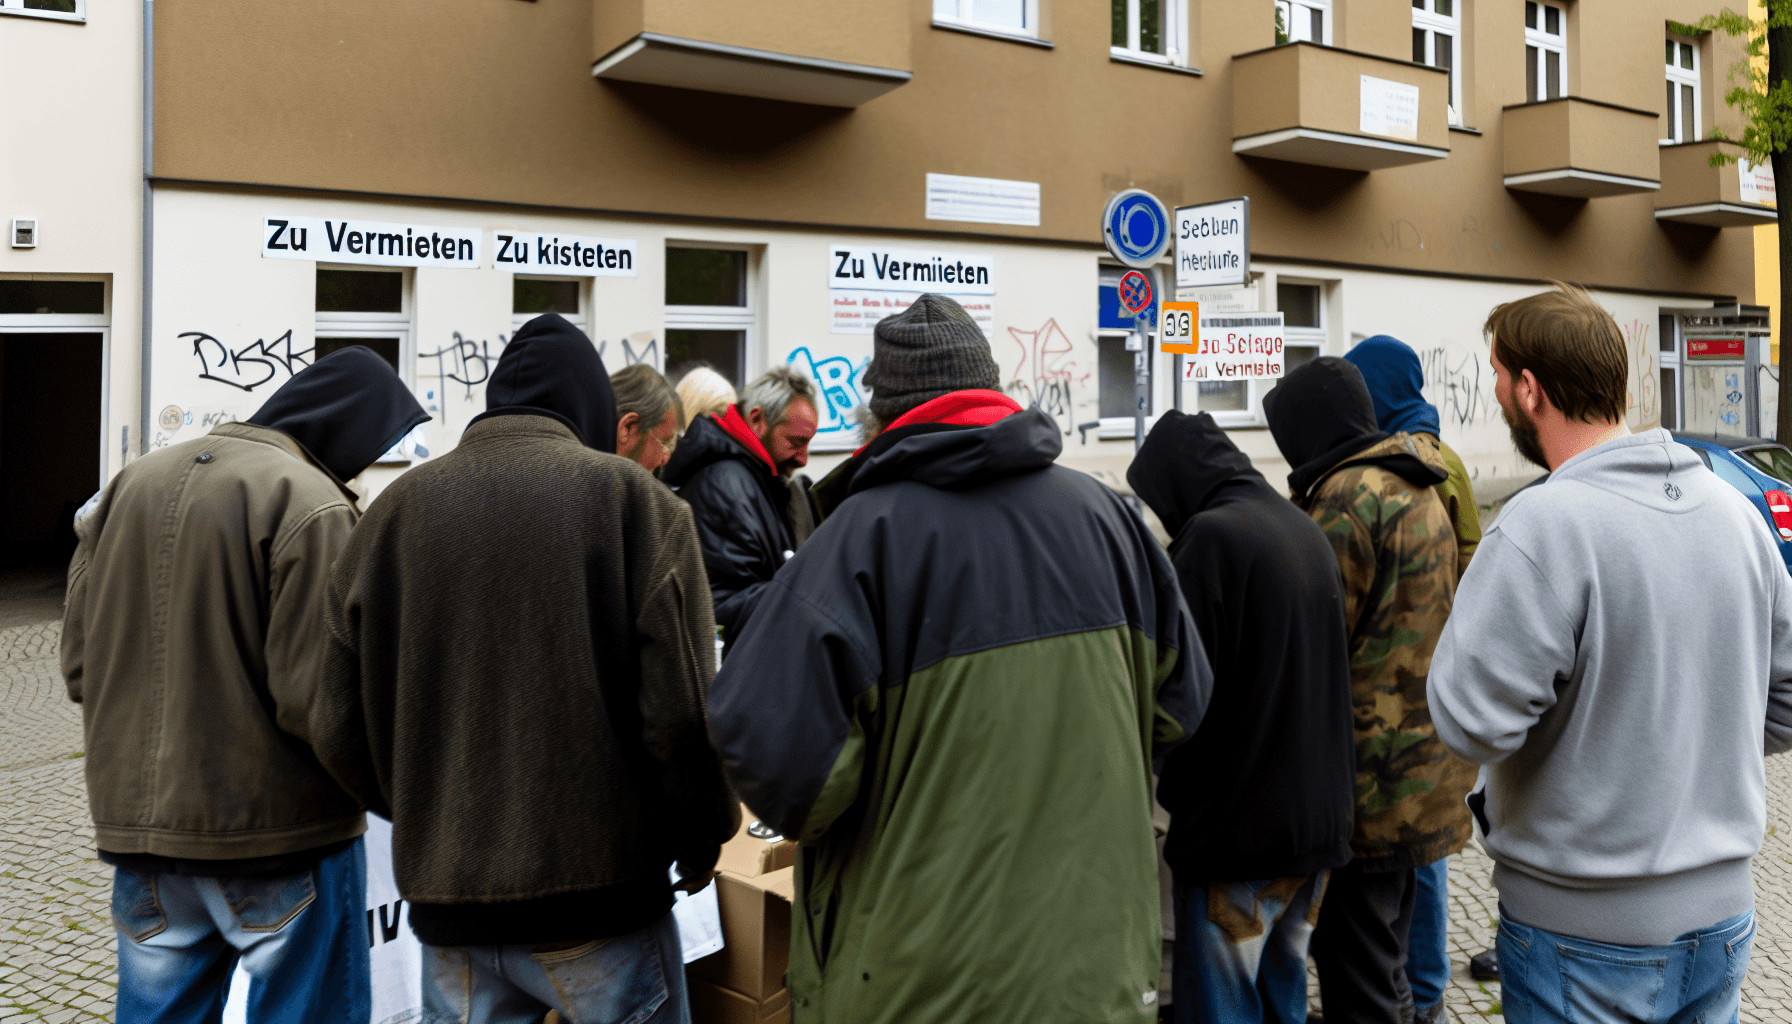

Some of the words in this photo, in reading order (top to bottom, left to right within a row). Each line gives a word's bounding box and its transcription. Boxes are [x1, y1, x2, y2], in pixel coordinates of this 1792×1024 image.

[266, 219, 307, 251] Zu
[325, 221, 474, 261] Vermieten
[496, 235, 528, 264] Zu
[537, 237, 633, 270] kisteten
[835, 251, 865, 279] Zu
